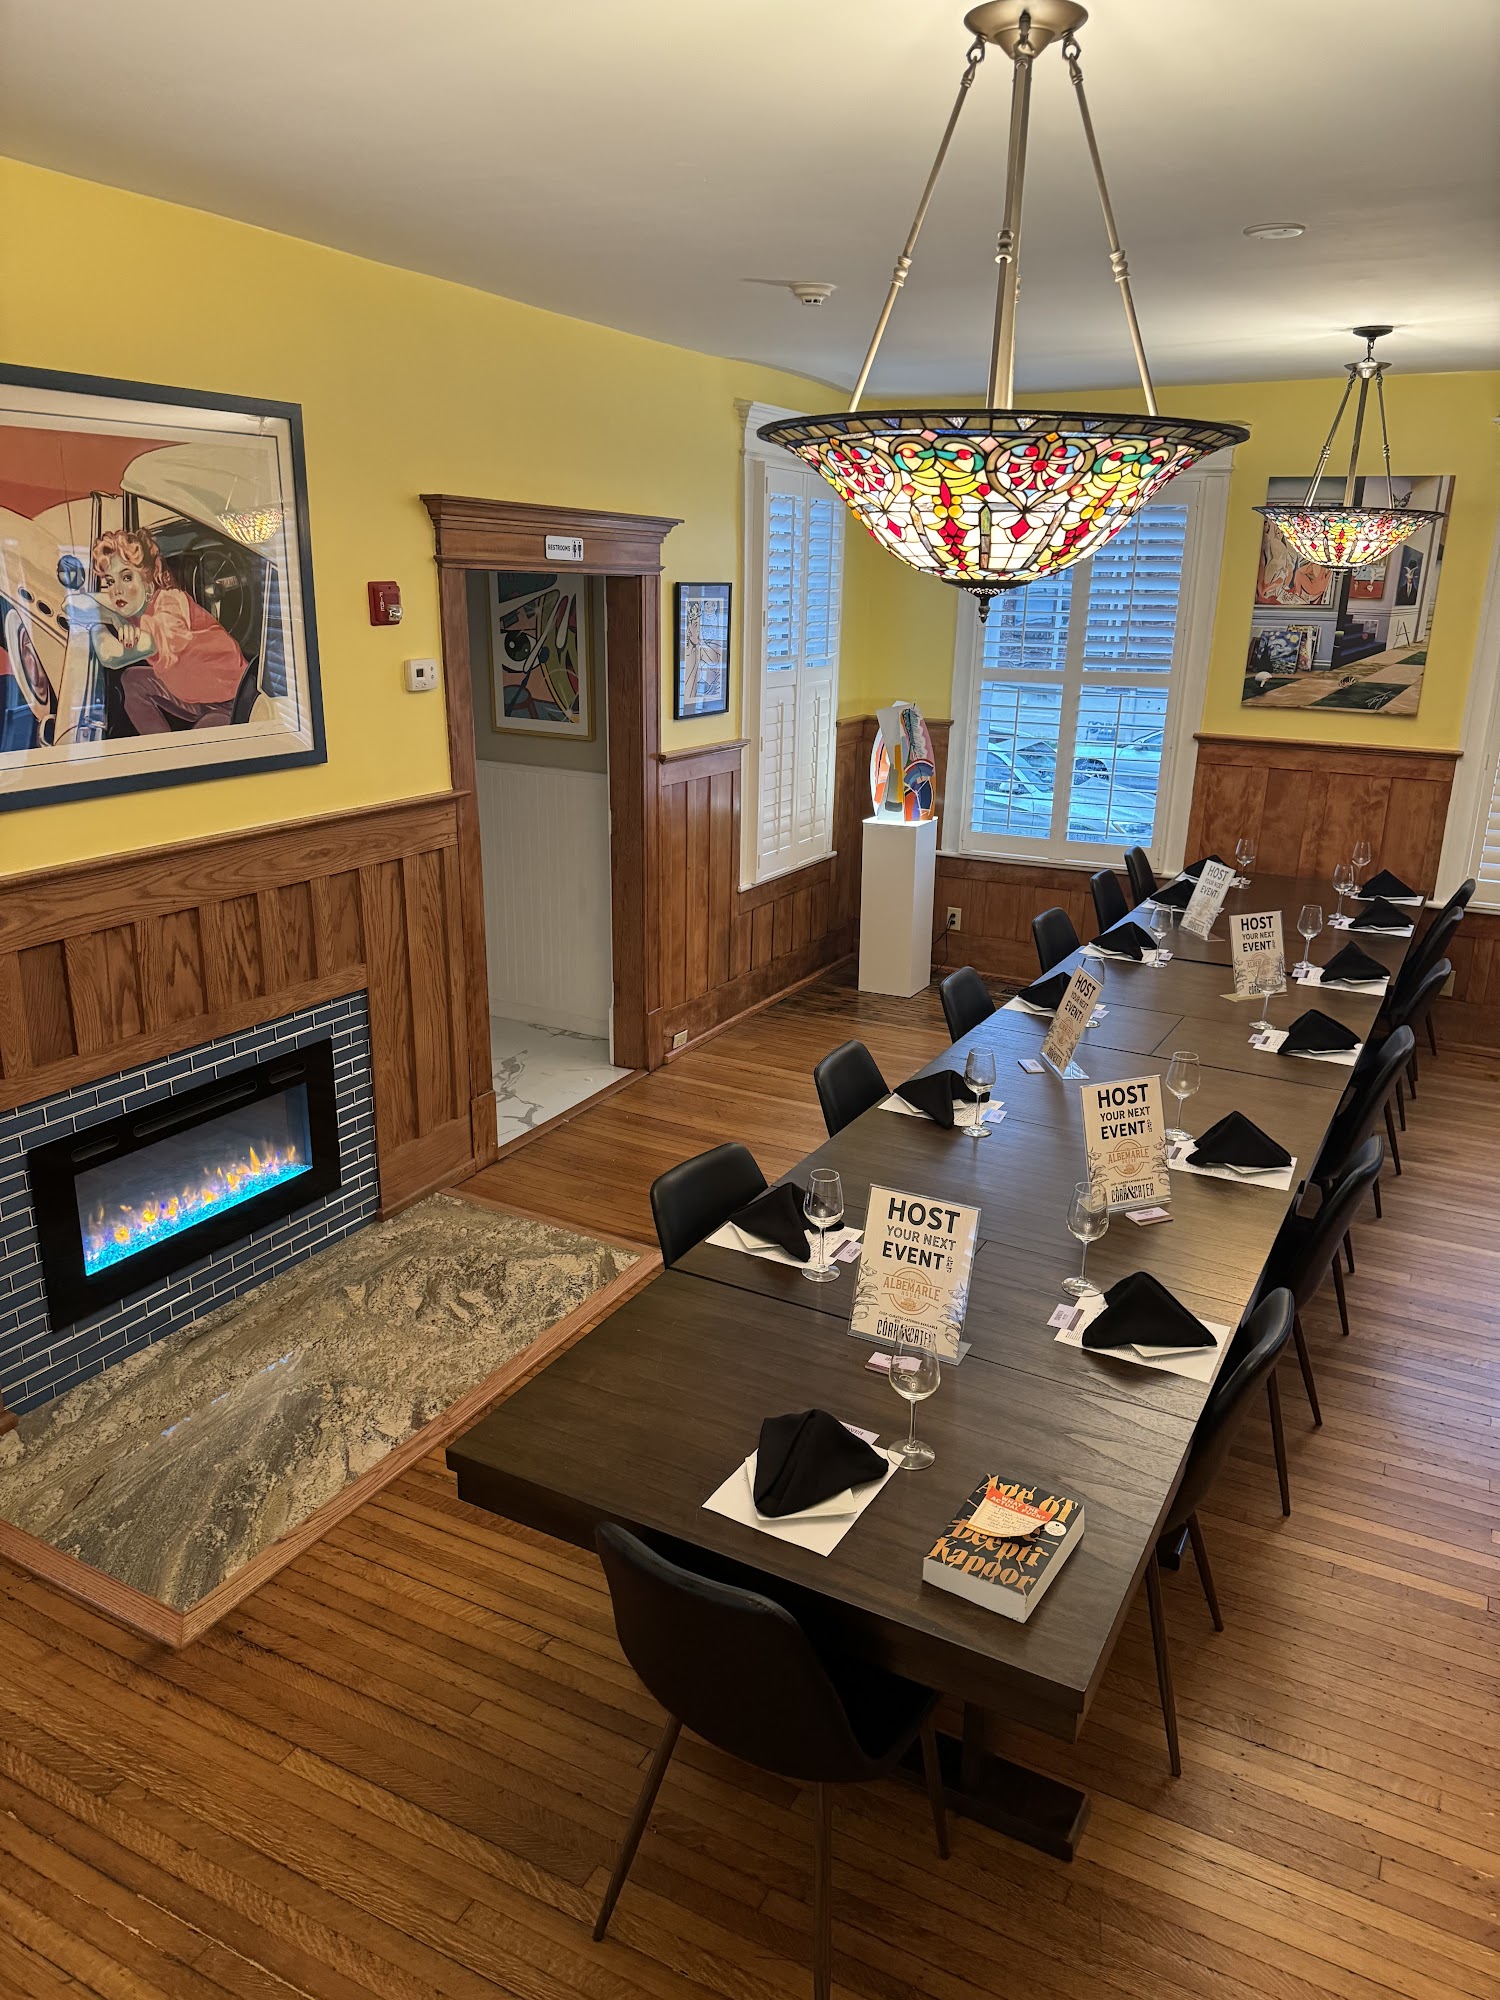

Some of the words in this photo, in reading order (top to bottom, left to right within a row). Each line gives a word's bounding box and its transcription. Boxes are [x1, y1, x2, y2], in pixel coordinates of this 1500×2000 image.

[1207, 865, 1229, 881] HOST
[1200, 885, 1218, 899] EVENT
[1240, 915, 1274, 931] HOST
[1241, 932, 1259, 941] YOUR
[1260, 930, 1275, 939] NEXT
[1242, 940, 1272, 952] EVENT
[1074, 974, 1096, 1000] HOST
[1064, 1000, 1083, 1020] EVENT
[1097, 1083, 1149, 1109] HOST
[1100, 1109, 1125, 1122] YOUR
[1128, 1106, 1151, 1119] NEXT
[1101, 1120, 1146, 1140] EVENT
[1108, 1148, 1150, 1165] ALBEMARLE
[887, 1197, 961, 1234] HOST
[887, 1225, 919, 1244] YOUR
[923, 1233, 957, 1251] NEXT
[882, 1240, 945, 1270] EVENT
[882, 1277, 941, 1302] ALBEMARLE
[901, 1291, 921, 1300] HOUSE
[990, 1496, 1020, 1512] ACTUAL
[1001, 1495, 1023, 1508] WHAT
[1025, 1505, 1040, 1514] THE
[926, 1536, 1037, 1594] Kapoor
